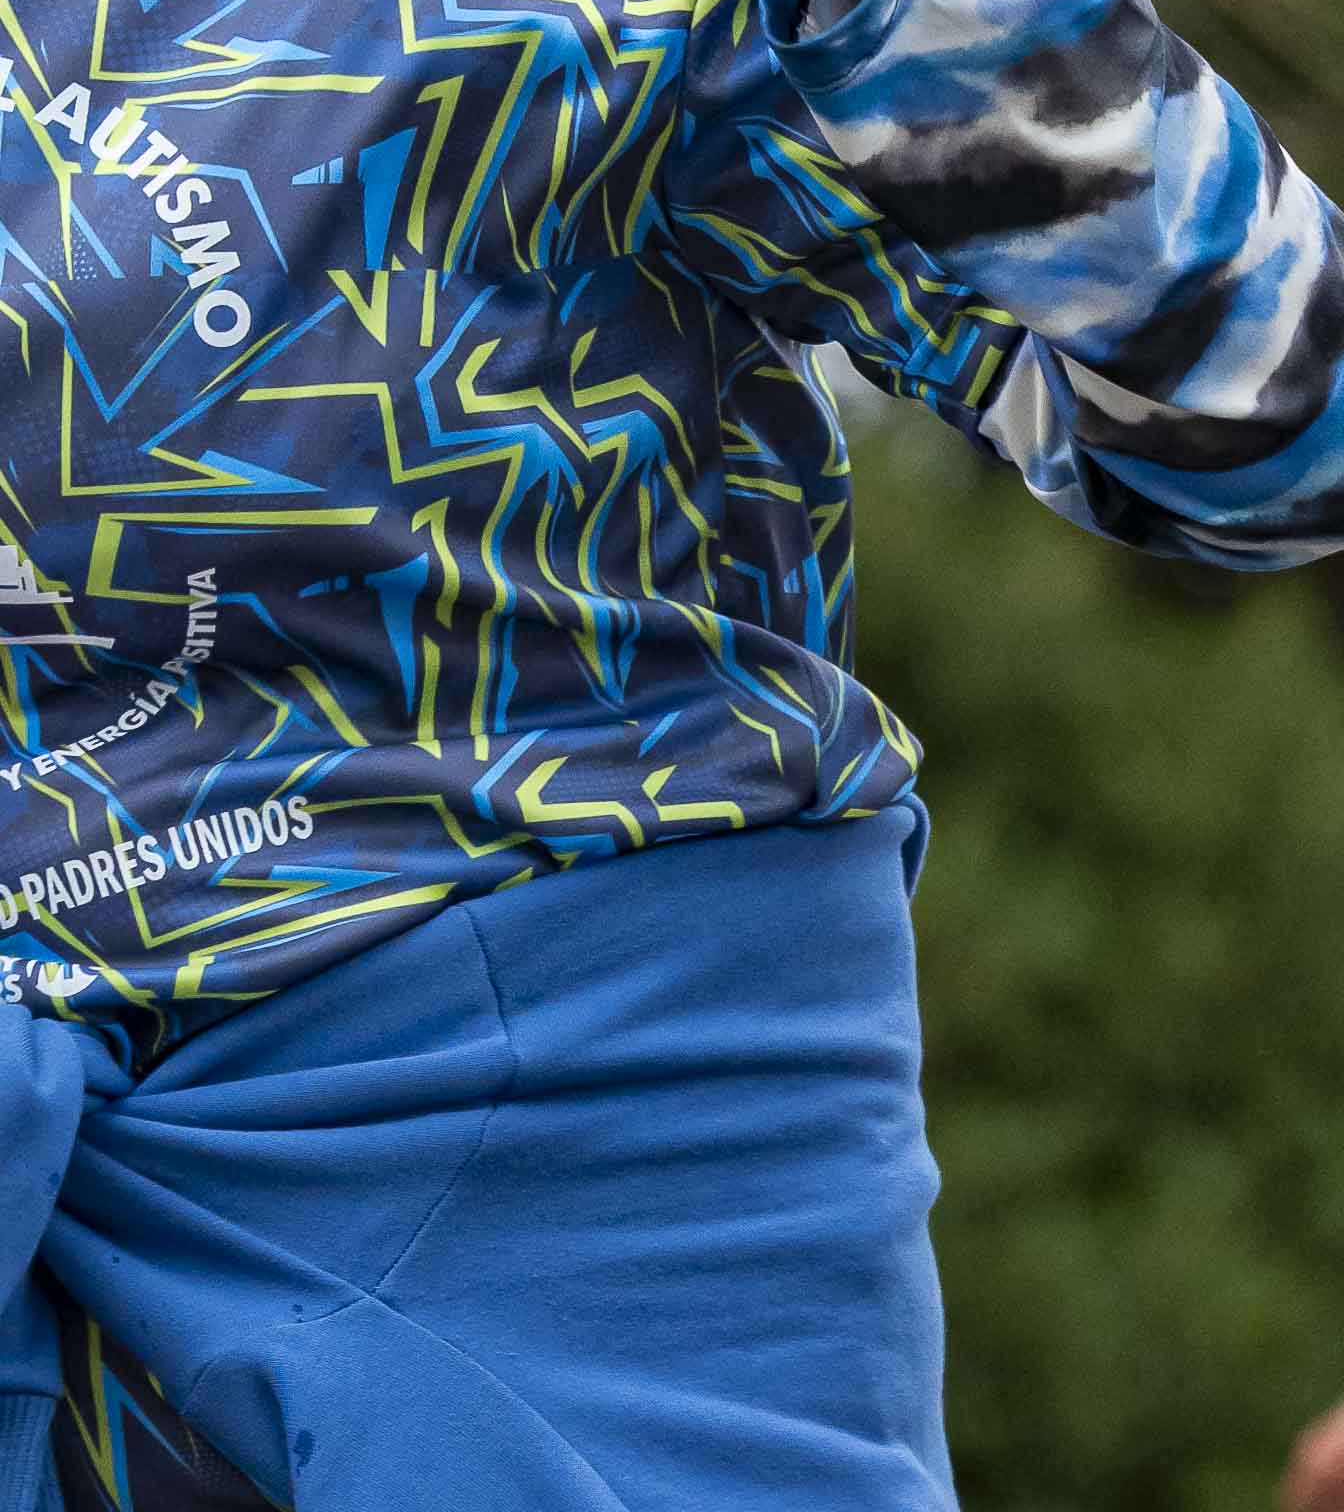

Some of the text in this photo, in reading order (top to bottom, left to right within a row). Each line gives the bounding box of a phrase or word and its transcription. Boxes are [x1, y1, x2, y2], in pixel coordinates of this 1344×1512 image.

[33, 82, 251, 348] AUTISMO
[32, 678, 179, 777] ENERGÍA
[20, 834, 167, 920] PADRES
[168, 795, 314, 870] UNIDOS
